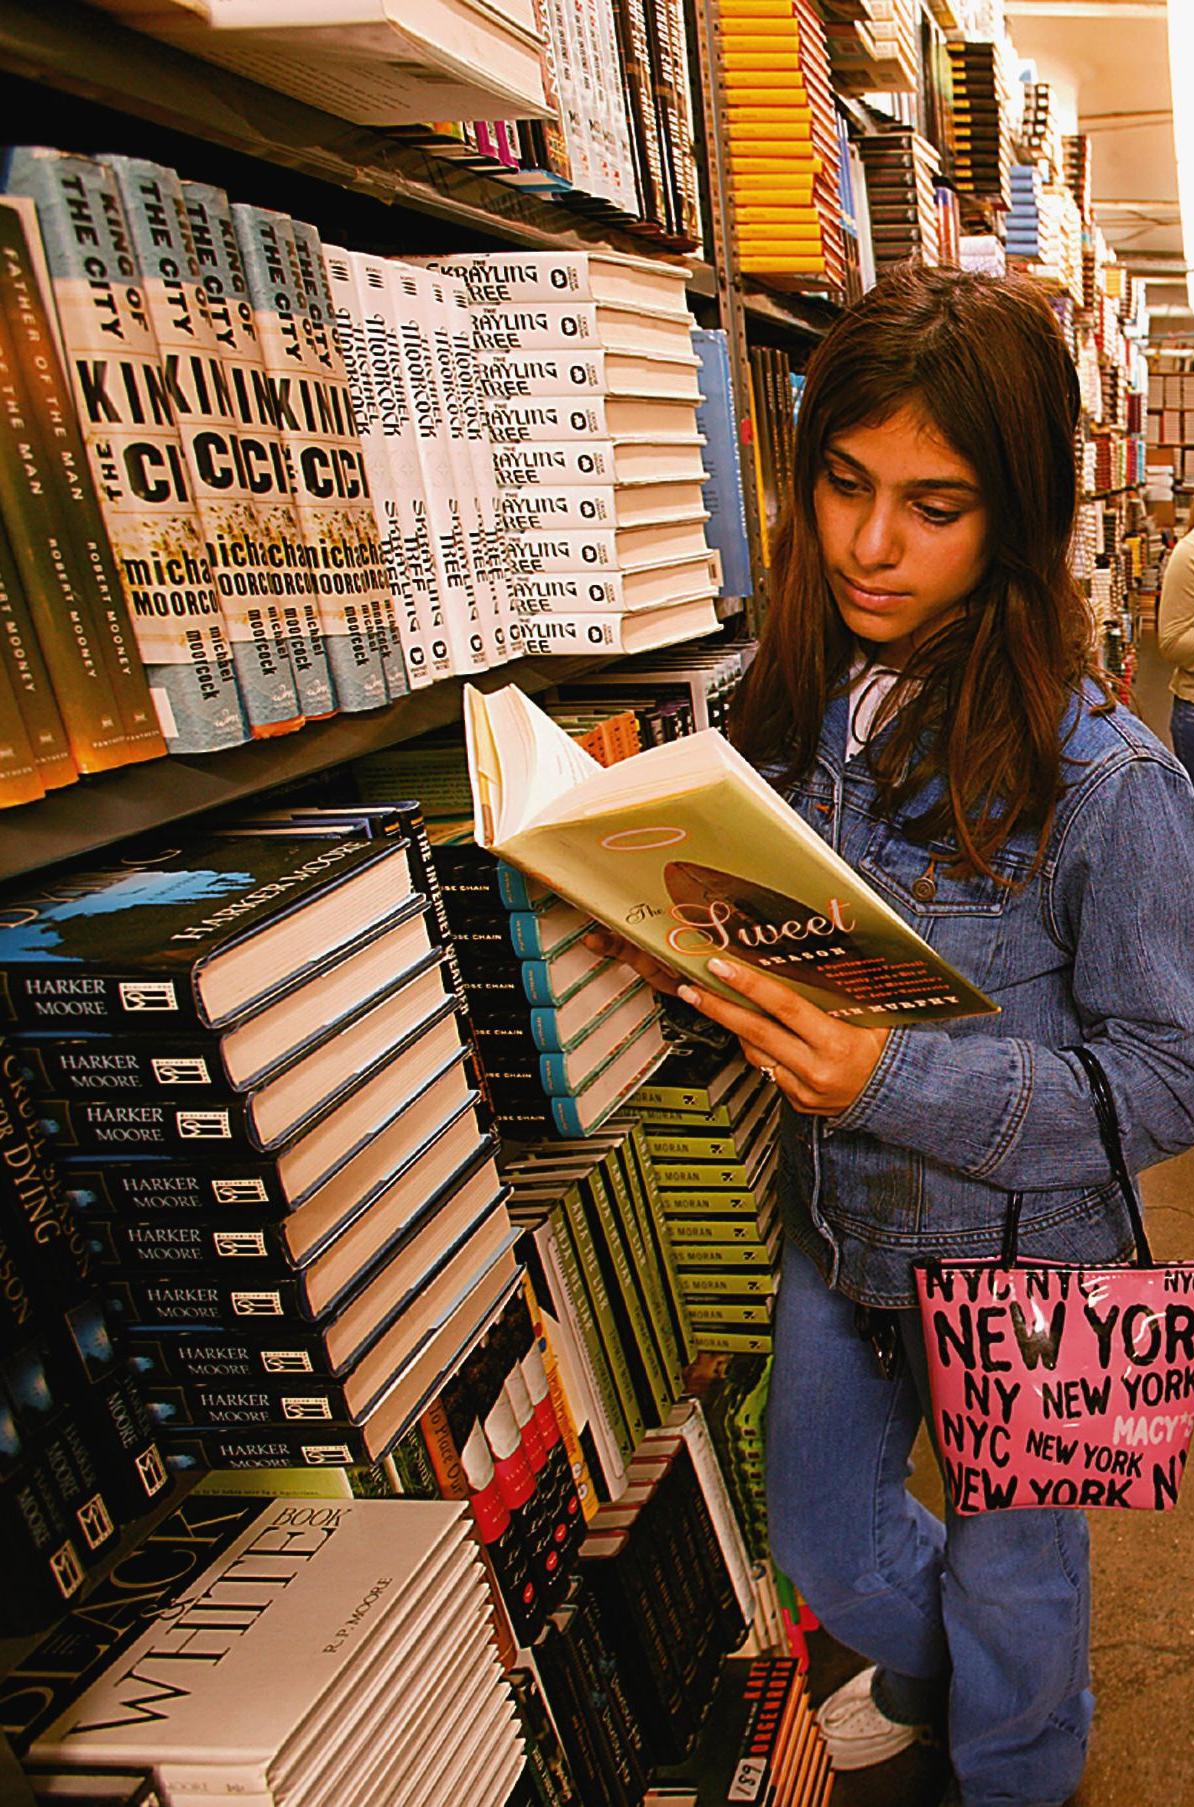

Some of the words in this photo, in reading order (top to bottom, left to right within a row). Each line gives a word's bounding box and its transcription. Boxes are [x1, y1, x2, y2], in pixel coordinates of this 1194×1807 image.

[60, 175, 99, 247] THE
[84, 256, 125, 340] CITY
[100, 192, 134, 277] KING
[125, 287, 149, 331] OF
[140, 181, 172, 247] THE
[158, 256, 194, 337] CITY
[184, 202, 217, 268] THE
[203, 274, 236, 349] CITY
[219, 218, 244, 292] KING
[237, 302, 257, 341] OF
[260, 225, 285, 285] THE
[274, 292, 302, 361] CITY
[5, 249, 41, 344] FATHER
[35, 355, 51, 385] OF
[45, 395, 67, 438] THE
[60, 450, 84, 501] MAN
[4, 384, 25, 430] THE
[18, 443, 43, 496] MAN
[440, 536, 462, 587] TREE
[48, 537, 75, 607] ROBERT
[69, 610, 98, 679] MOONEY
[86, 541, 110, 607] ROBERT
[106, 610, 132, 678] MOONEY
[267, 606, 289, 661] michael
[303, 605, 325, 656] michael
[361, 604, 380, 653] michael
[6, 621, 36, 694] MOONEY
[209, 625, 235, 684] michael
[248, 609, 278, 677] moorcock
[284, 607, 311, 672] moorcock
[344, 606, 370, 668] moorcock
[186, 630, 219, 701] moorcock
[171, 879, 293, 941] HARKER
[285, 840, 371, 883] MOORE
[416, 832, 431, 862] THE
[425, 864, 450, 939] INTERNET
[624, 903, 664, 925] The
[665, 897, 859, 957] Sweet
[758, 946, 847, 967] SEASON
[26, 979, 107, 995] HARKER
[36, 1000, 108, 1016] MOORE
[866, 995, 961, 1013] MURPHY
[60, 1055, 140, 1070] HARKER
[70, 1075, 142, 1088] MOORE
[87, 1108, 164, 1122] HARKER
[96, 1128, 165, 1142] MOORE
[4, 1144, 60, 1244] DYING
[123, 1177, 200, 1191] HARKER
[133, 1196, 202, 1208] MOORE
[128, 1229, 202, 1242] HARKER
[138, 1247, 202, 1260] MOORE
[584, 1244, 598, 1276] THE
[148, 1289, 218, 1302] HARKER
[568, 1260, 582, 1290] THE
[157, 1306, 220, 1319] MOORE
[933, 1301, 1066, 1372] NEW
[178, 1347, 249, 1360] HARKER
[188, 1364, 250, 1375] MOORE
[107, 1392, 138, 1449] MOORE
[200, 1393, 270, 1407] HARKER
[210, 1411, 270, 1422] MOORE
[964, 1371, 1021, 1423] NY
[1042, 1375, 1111, 1419] NEW
[221, 1444, 290, 1456] HARKER
[942, 1410, 1010, 1467] NYC
[1026, 1429, 1079, 1465] NEW
[1083, 1443, 1143, 1478] YORK
[945, 1456, 1018, 1511] NEW
[1029, 1478, 1134, 1508] YORK
[271, 1508, 353, 1528] BOOK
[61, 1526, 338, 1741] WHITE
